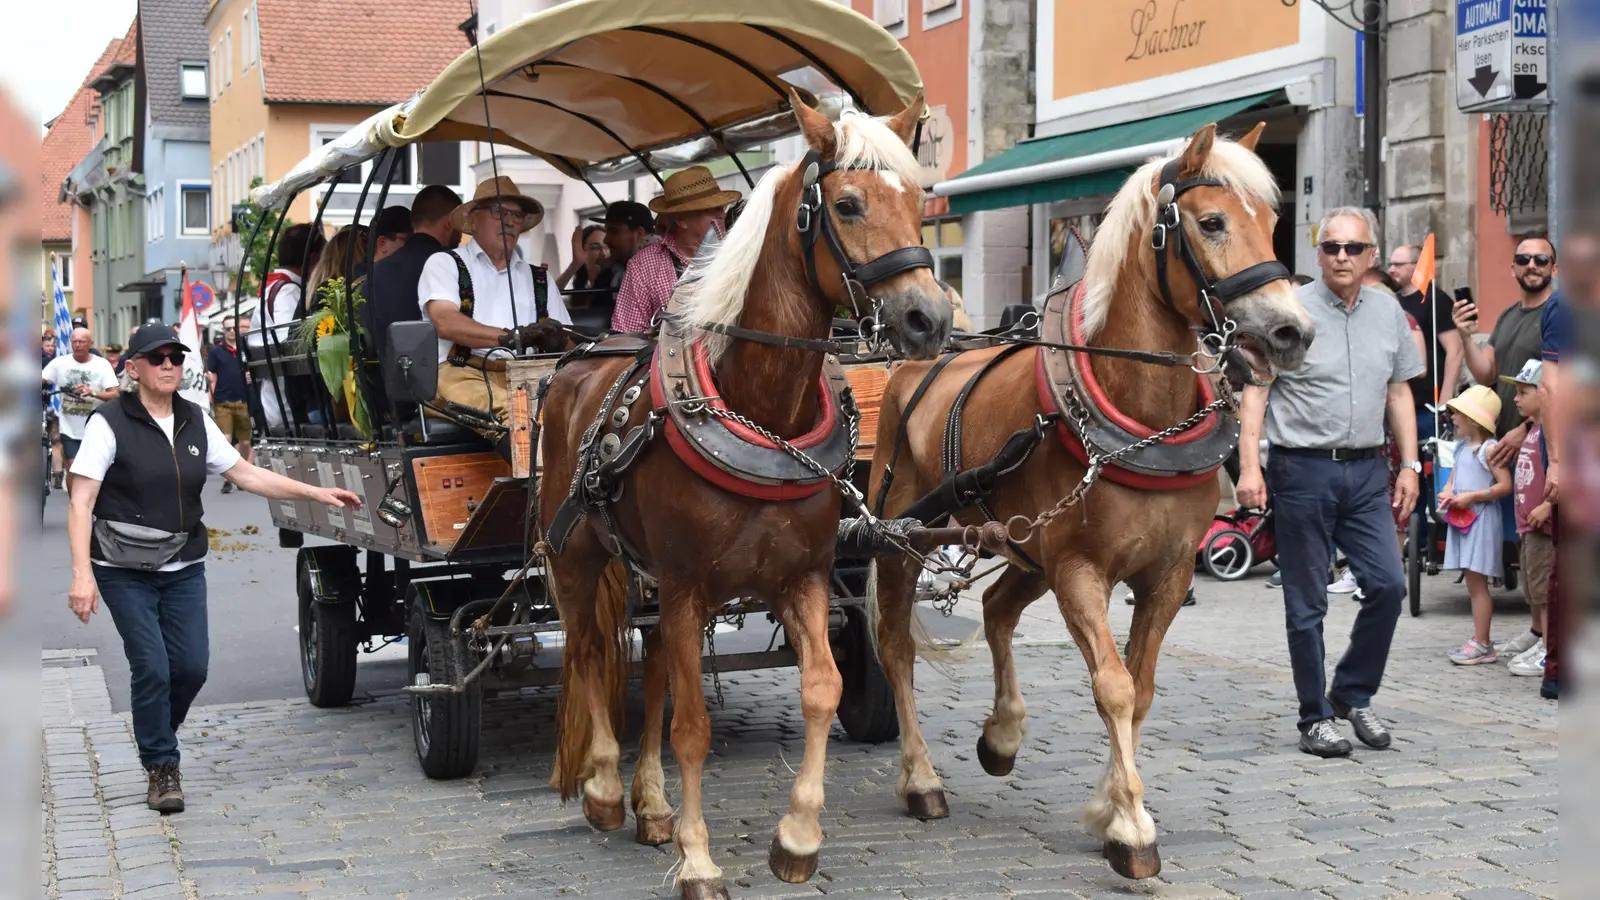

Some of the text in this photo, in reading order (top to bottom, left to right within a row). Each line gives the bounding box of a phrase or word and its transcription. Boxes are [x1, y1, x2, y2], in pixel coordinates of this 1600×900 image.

[1464, 0, 1501, 29] AUTOMAT
[1125, 0, 1206, 61] Lachner
[1457, 29, 1509, 53] Hier Parkschein
